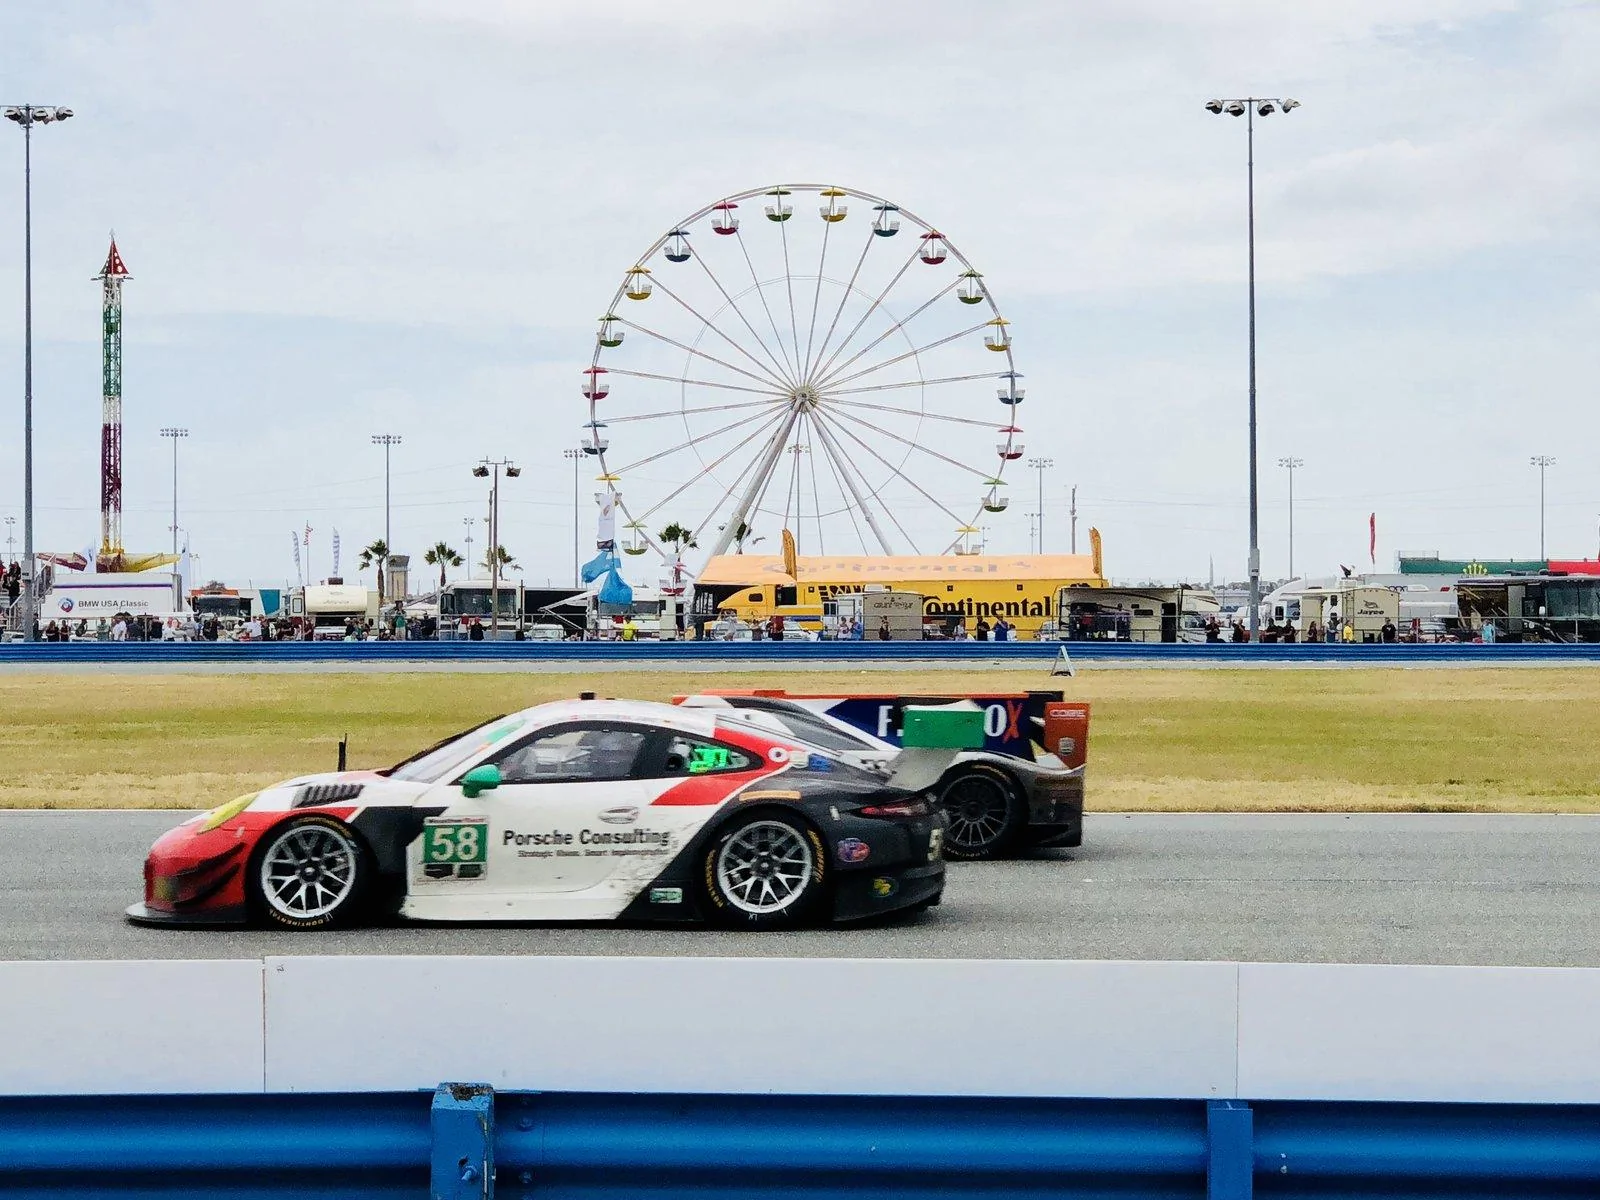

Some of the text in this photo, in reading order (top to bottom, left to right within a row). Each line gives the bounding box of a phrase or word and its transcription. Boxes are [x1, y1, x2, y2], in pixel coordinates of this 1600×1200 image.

[120, 599, 149, 607] Classic
[431, 826, 479, 861] 58
[503, 828, 671, 847] Porsche Consulting
